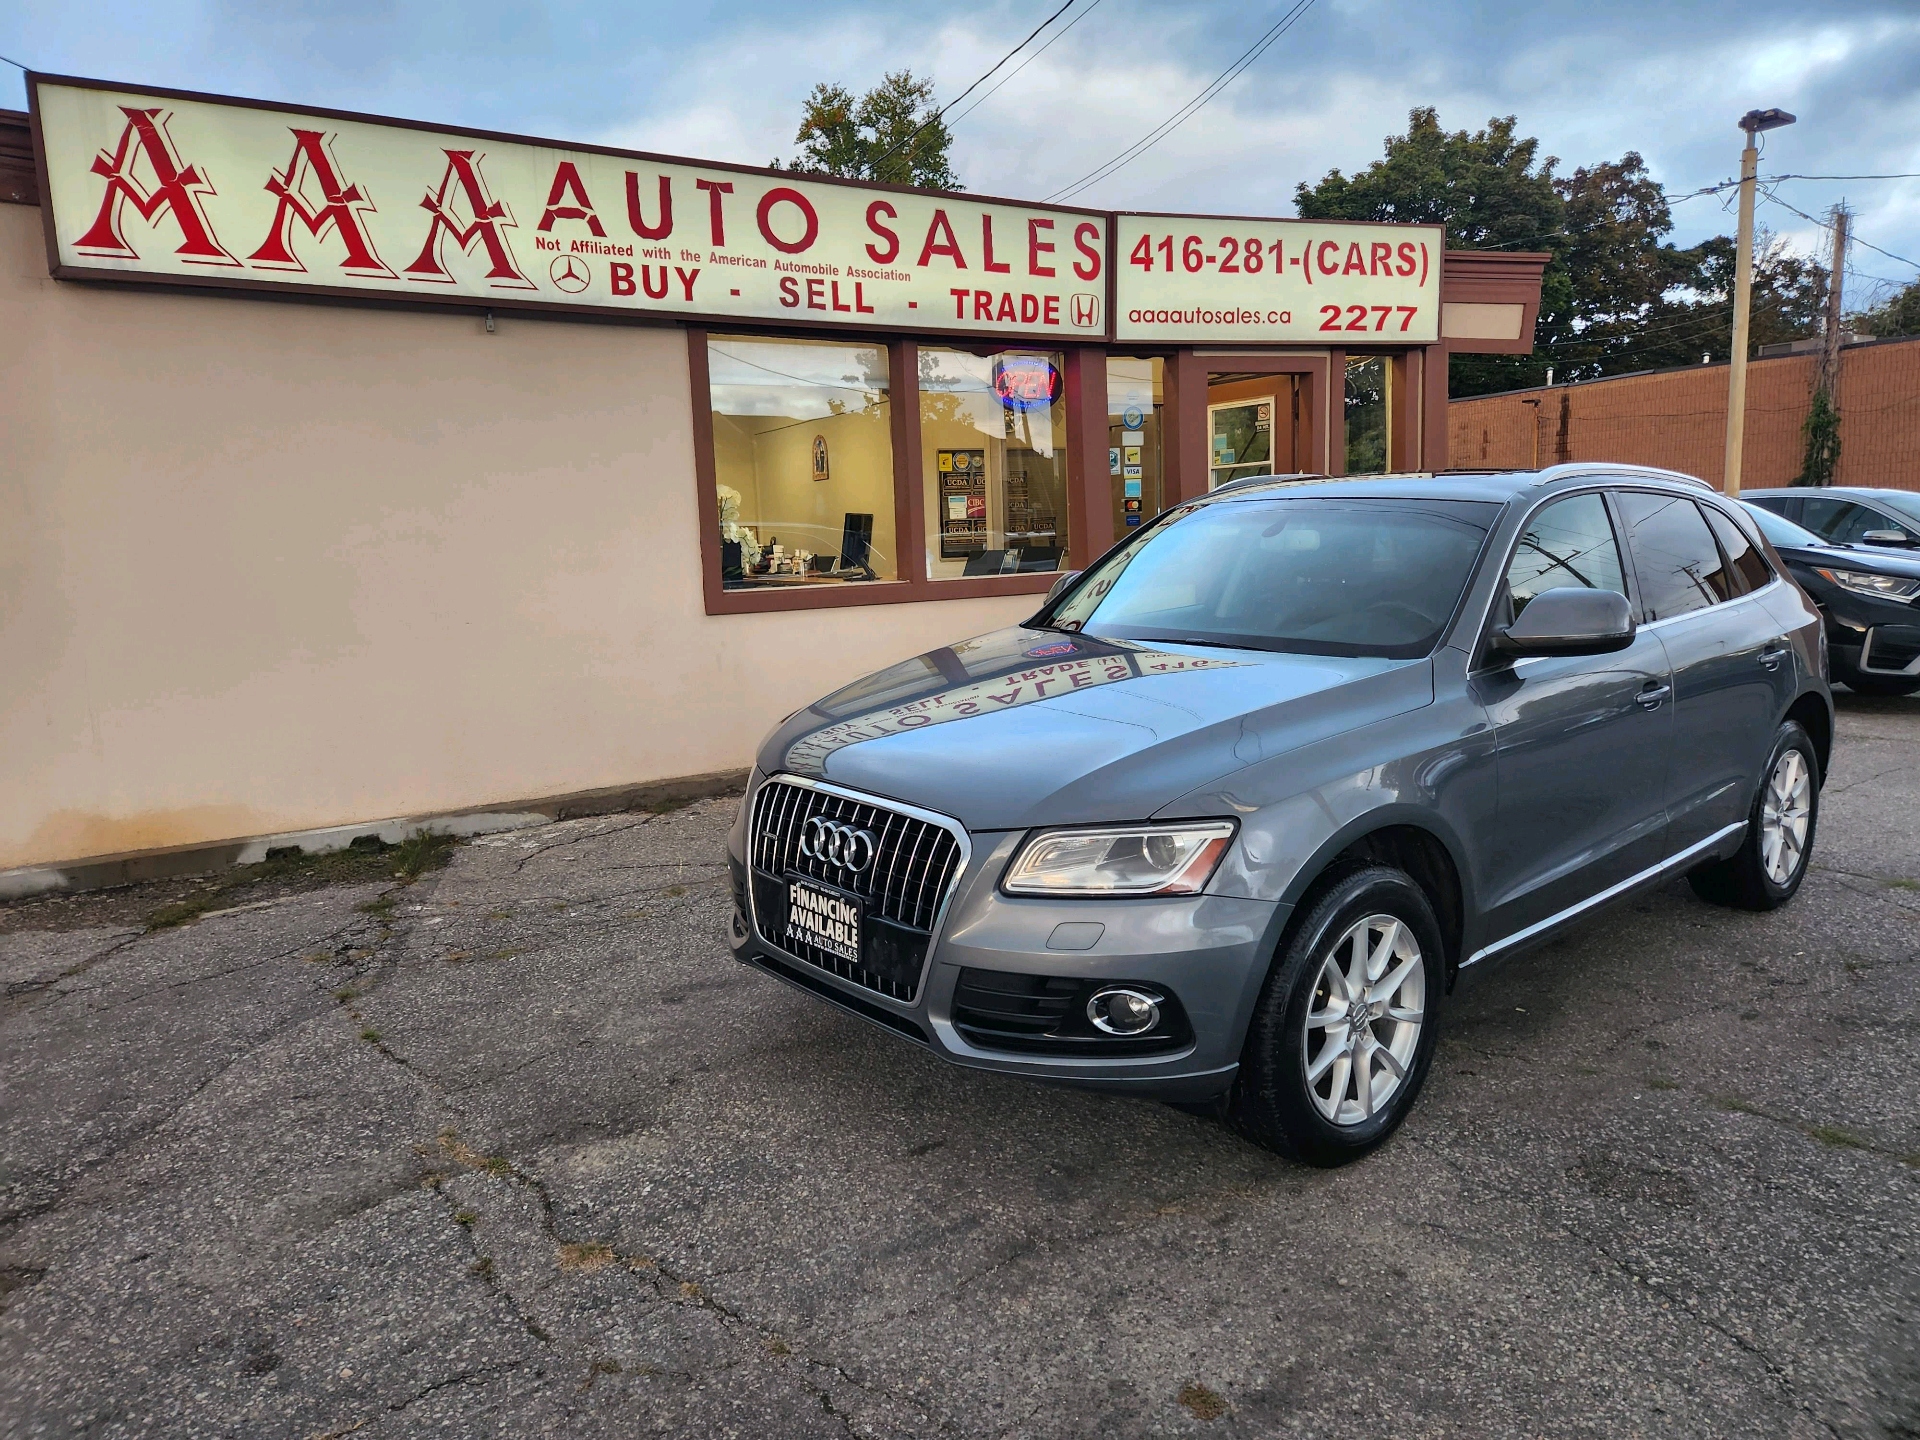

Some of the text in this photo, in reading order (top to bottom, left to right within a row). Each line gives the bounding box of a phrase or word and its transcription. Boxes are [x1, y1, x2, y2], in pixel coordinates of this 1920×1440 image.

[537, 160, 819, 255] AUTO
[865, 200, 1102, 282] SALES
[535, 236, 912, 282] Not Affiliated with the American Automobile Association
[1129, 234, 1429, 288] 416-281-(CARS)
[609, 262, 701, 302] BUY
[779, 276, 875, 314] SELL
[949, 288, 1060, 326] TRADE
[1128, 307, 1292, 325] aaaautosales.ca
[1319, 304, 1418, 333] 2277
[995, 371, 1057, 399] OPEN
[967, 498, 985, 507] CIBC
[789, 884, 858, 928] FINANCING
[789, 904, 858, 949] AVAILABLE
[834, 942, 858, 959] SALES
